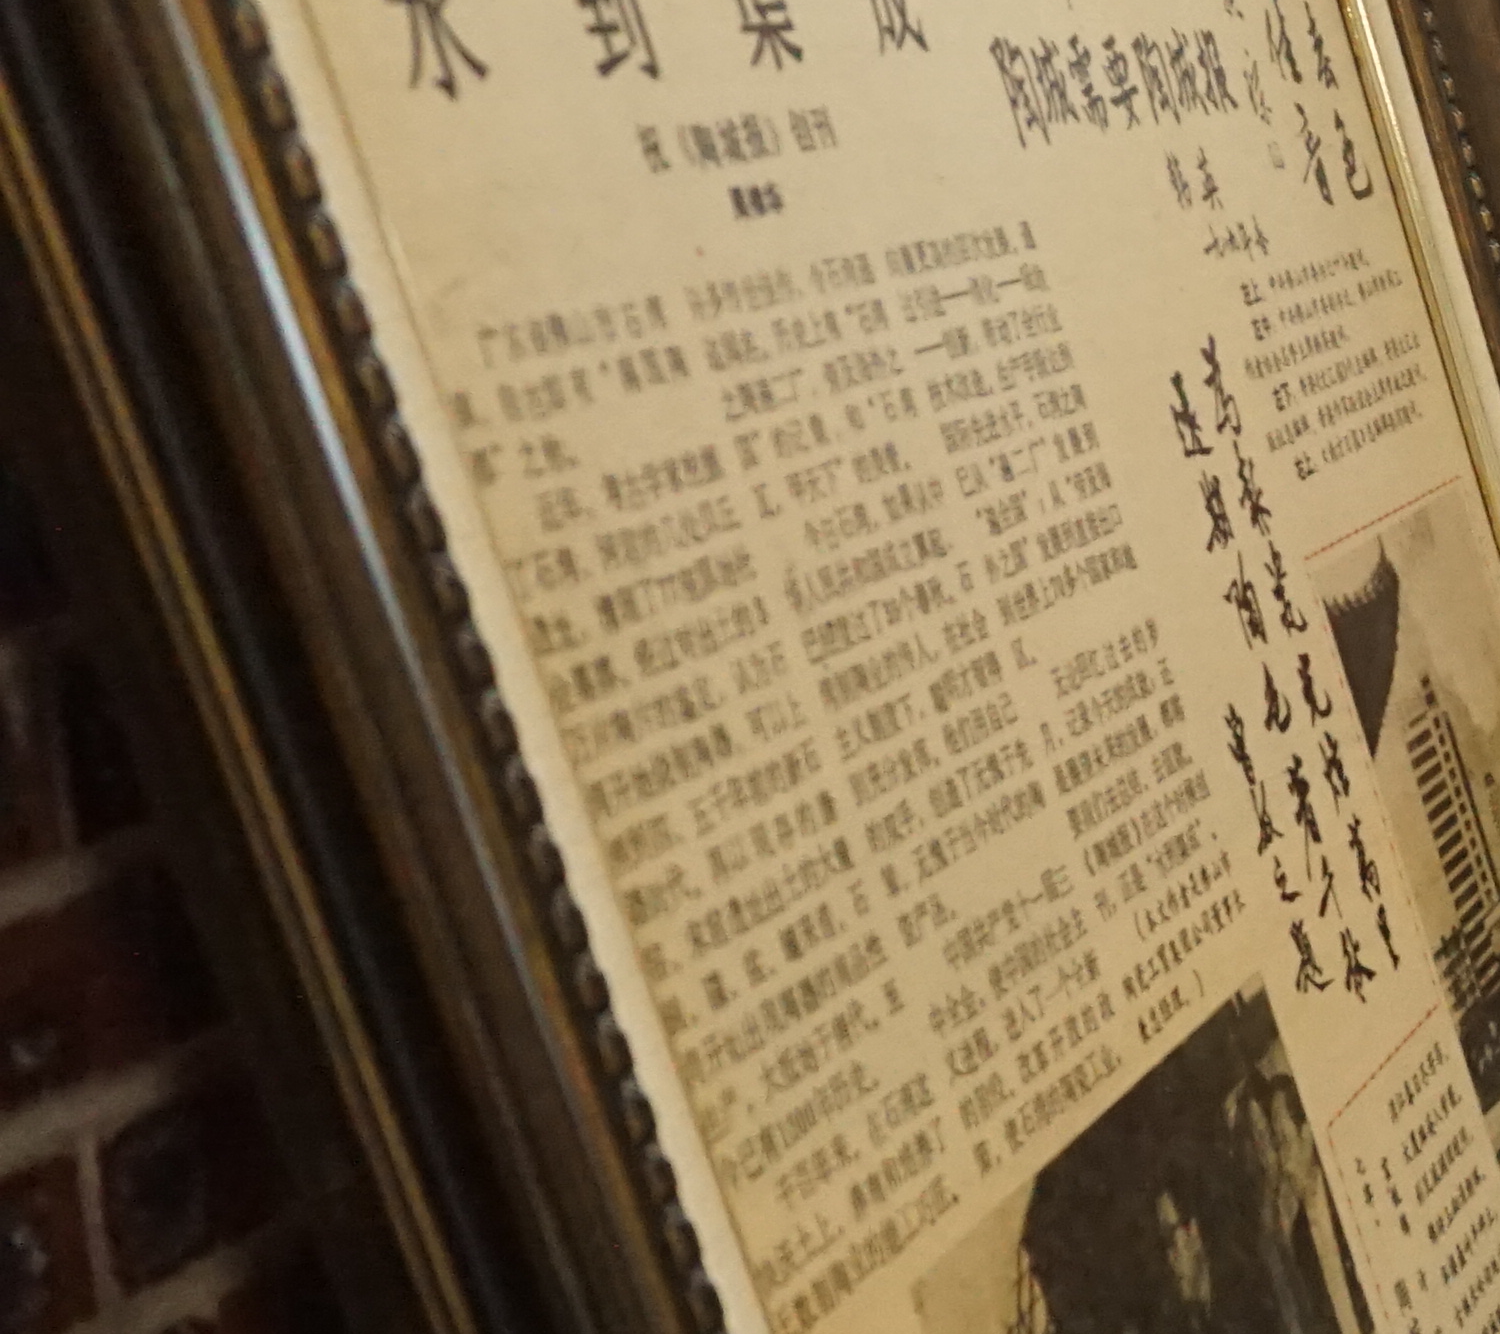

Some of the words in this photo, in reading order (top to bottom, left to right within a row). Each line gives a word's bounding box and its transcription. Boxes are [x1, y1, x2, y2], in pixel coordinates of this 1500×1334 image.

[992, 29, 1238, 149] 陶城需要陶城报
